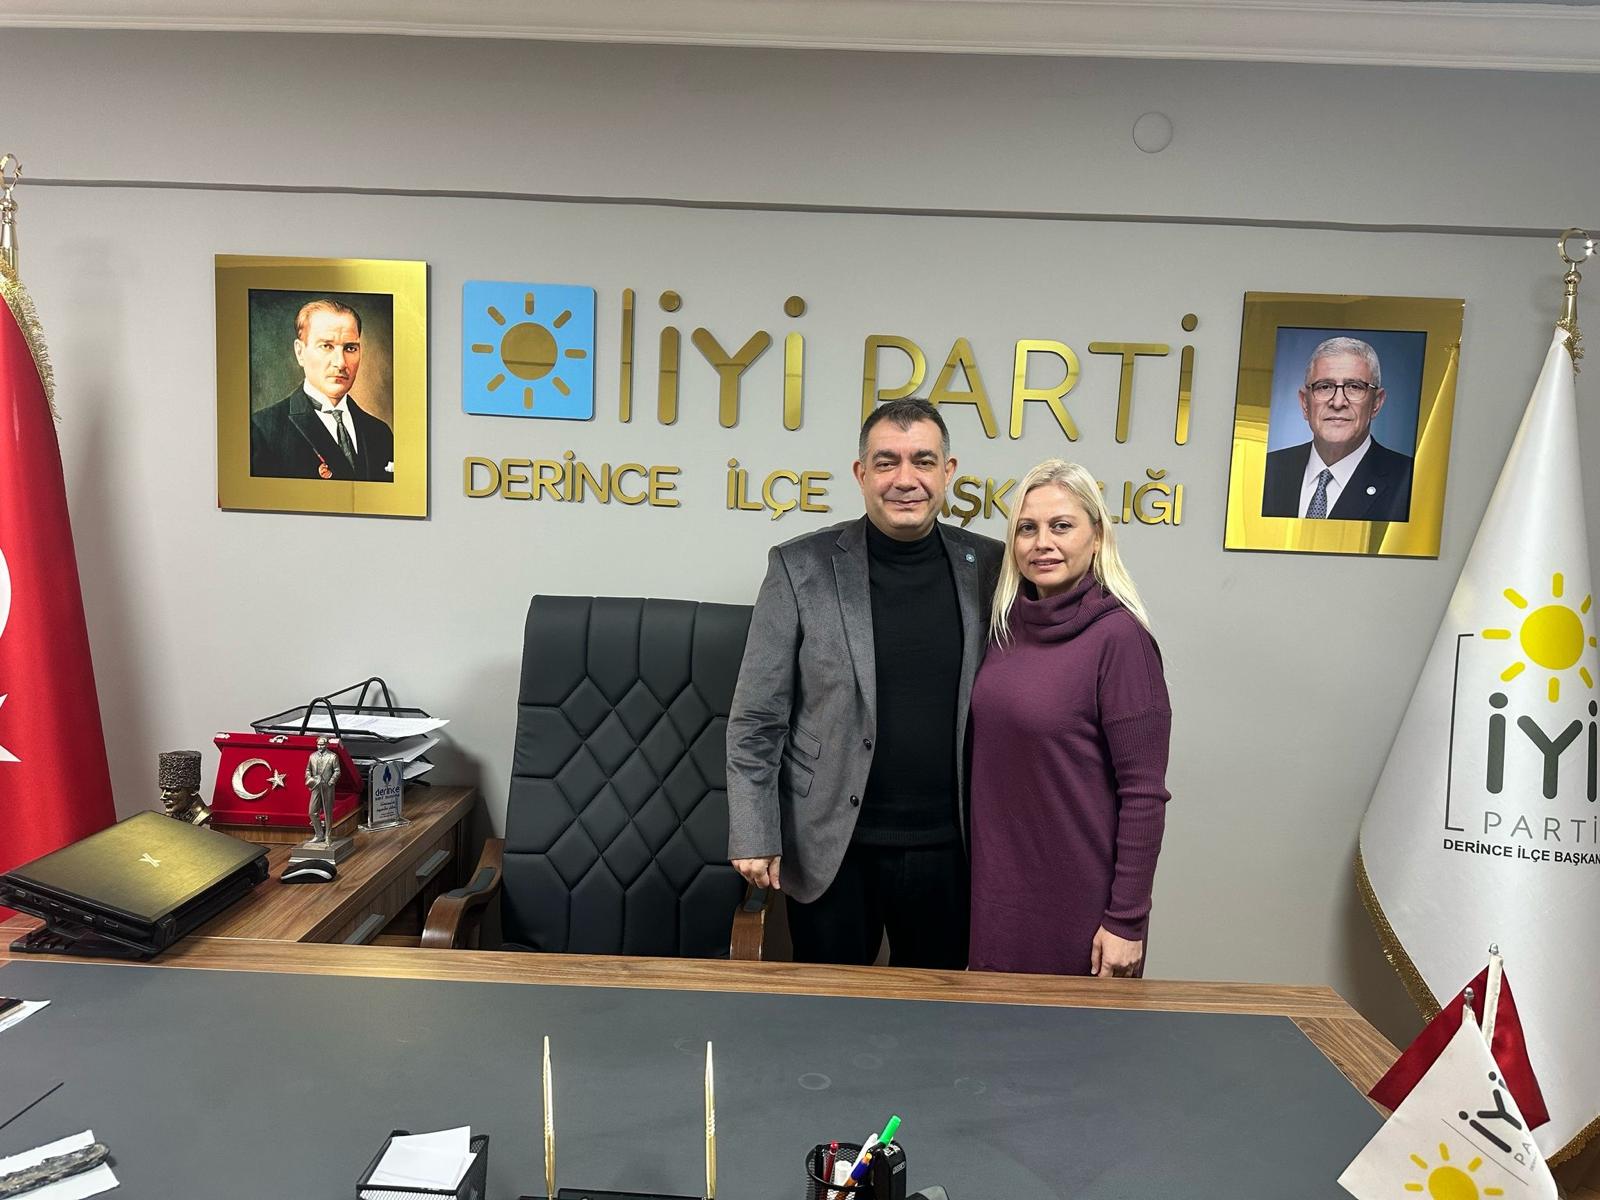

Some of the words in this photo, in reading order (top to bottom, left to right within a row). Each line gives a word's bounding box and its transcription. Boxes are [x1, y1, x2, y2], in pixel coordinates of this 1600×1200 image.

[861, 313, 1199, 446] PARTİ
[463, 450, 680, 507] DERİNCE
[726, 458, 832, 521] İLÇE
[1443, 838, 1513, 858] DERİNCE
[1517, 844, 1551, 863] İLÇE
[1483, 811, 1598, 844] PARTİ
